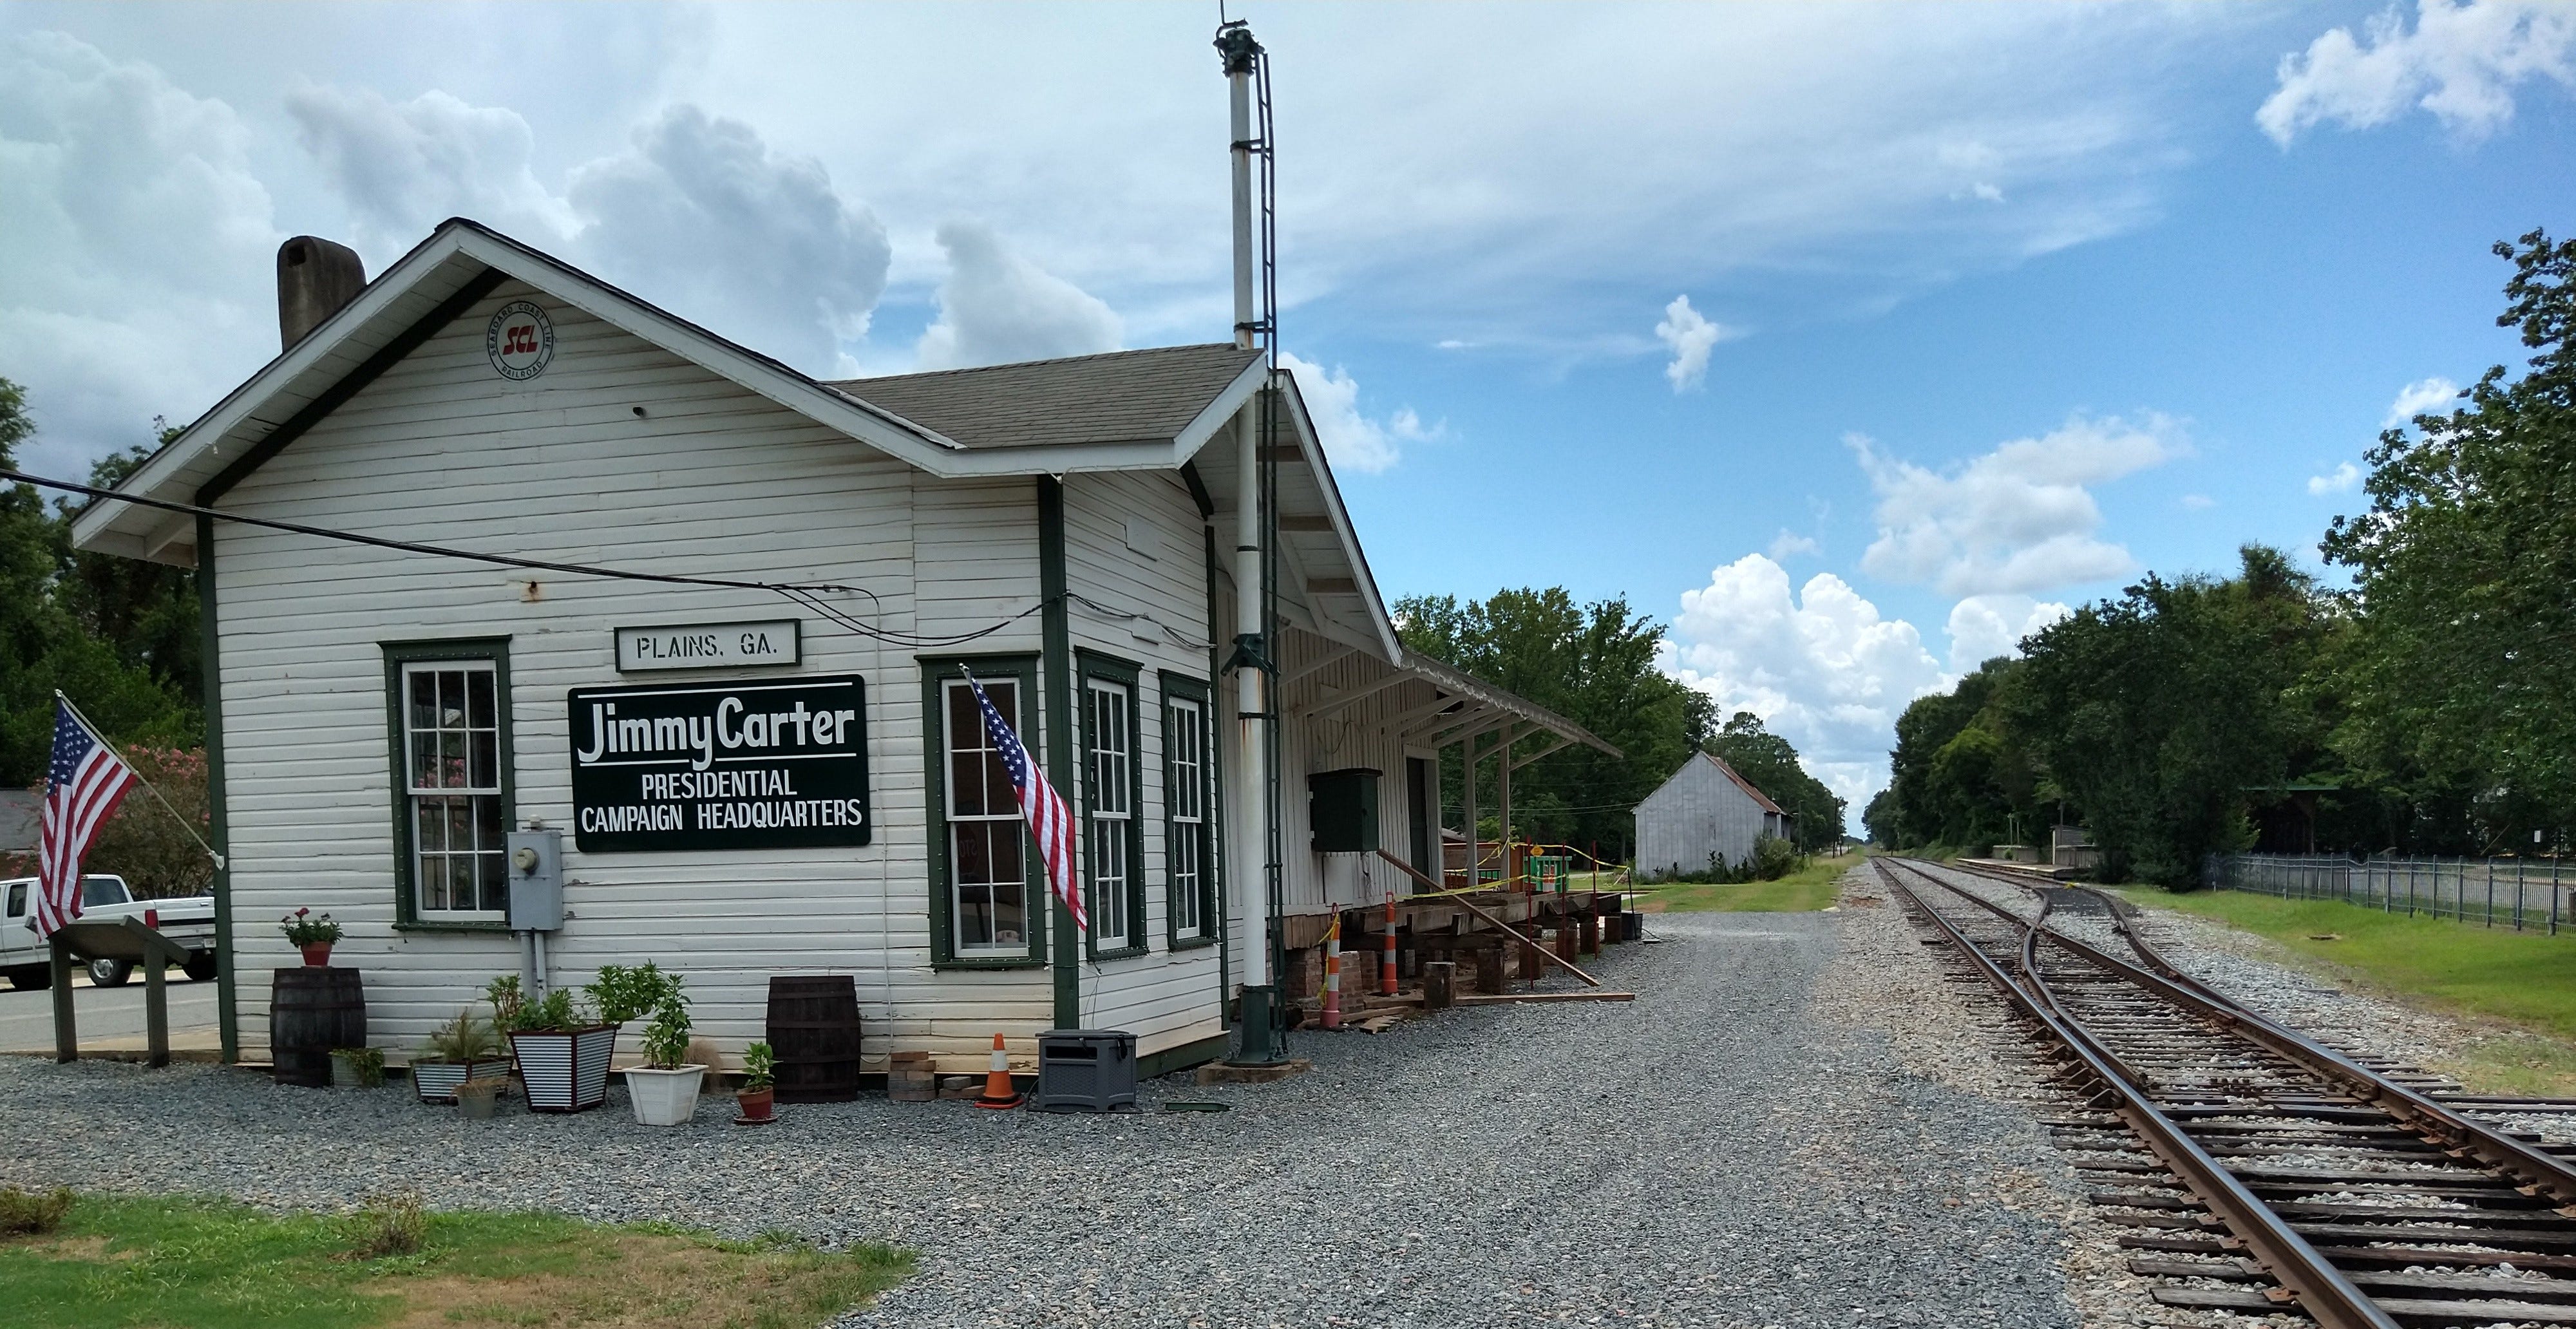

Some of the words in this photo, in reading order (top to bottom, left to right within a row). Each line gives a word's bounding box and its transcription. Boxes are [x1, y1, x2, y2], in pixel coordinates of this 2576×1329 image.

[489, 306, 513, 357] SEABOARD
[518, 303, 544, 319] COAST
[503, 325, 538, 355] SCL
[502, 361, 542, 378] RAILROAD
[741, 633, 777, 655] GA.
[642, 769, 797, 800] PRESIDENTIAL
[582, 805, 683, 833] CAMPAIGN
[697, 799, 862, 829] HEADQUARTERS
